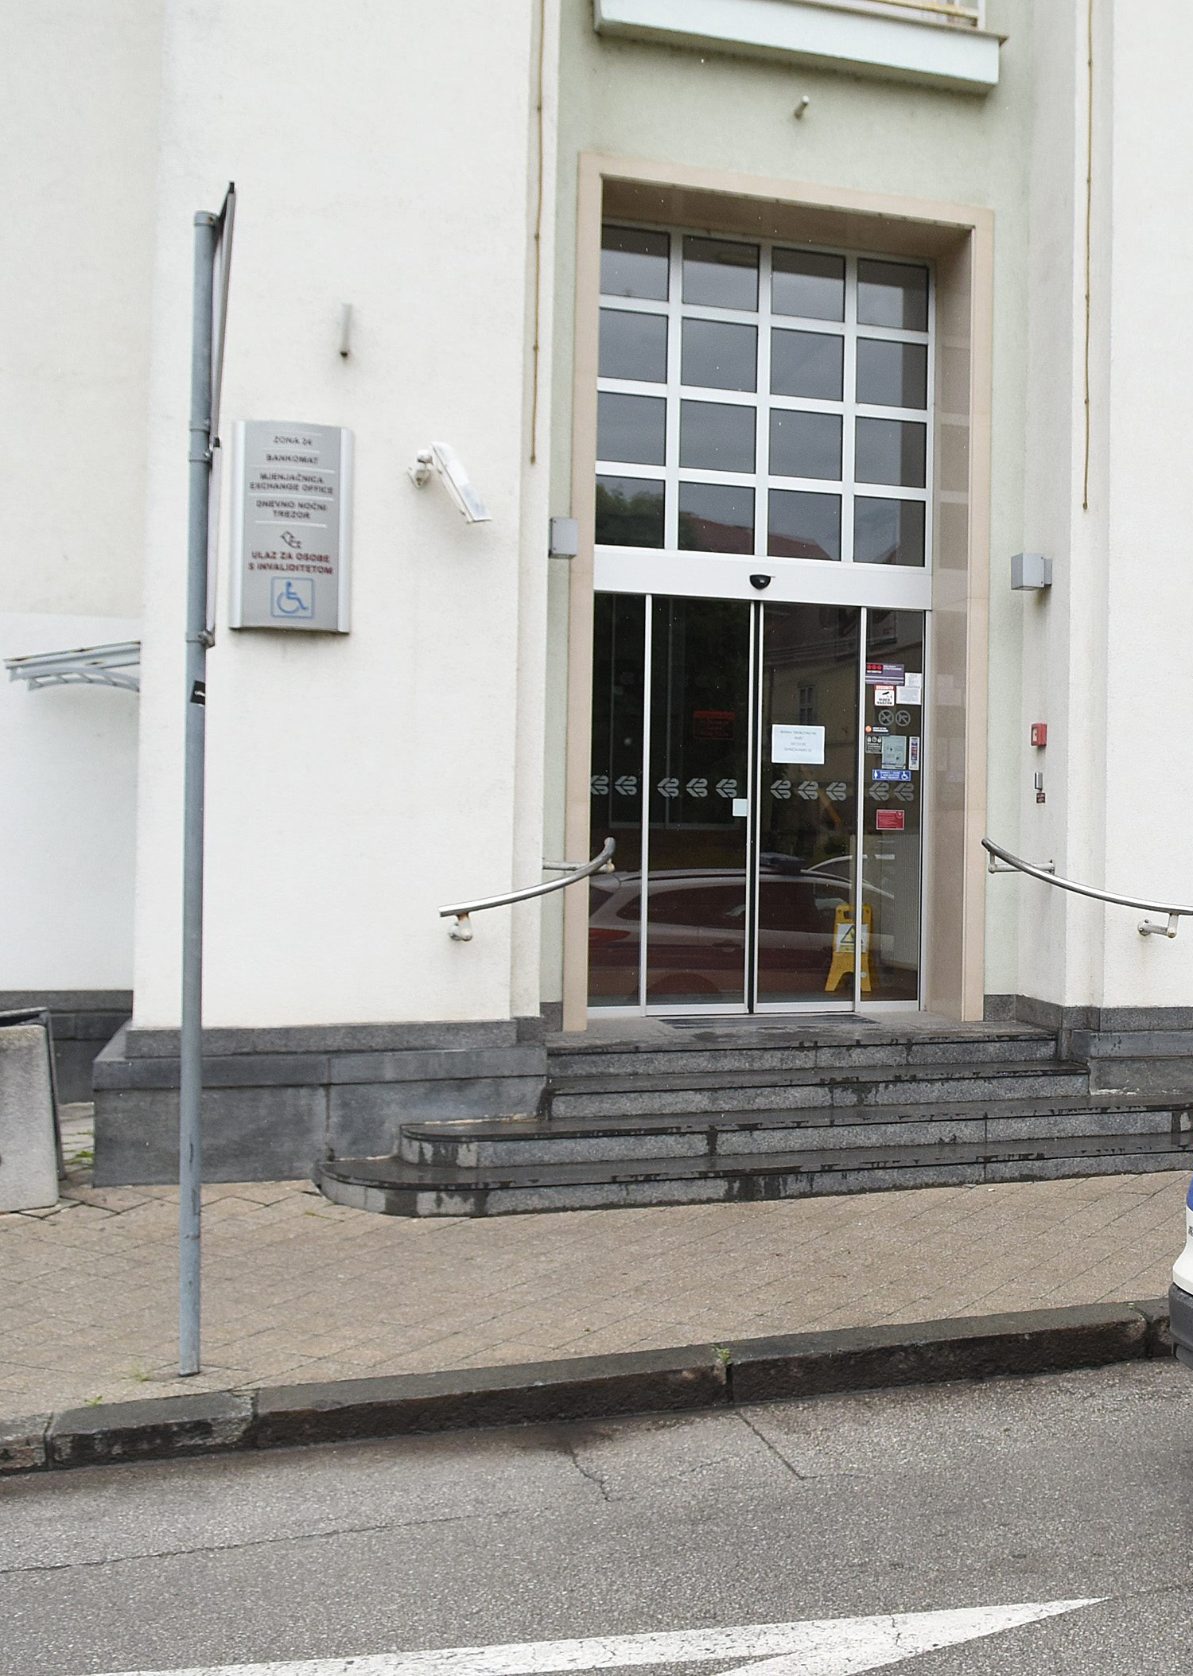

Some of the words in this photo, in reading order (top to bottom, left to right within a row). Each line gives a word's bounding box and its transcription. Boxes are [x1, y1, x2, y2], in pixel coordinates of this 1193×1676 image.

[267, 455, 318, 464] BANKOMAT
[250, 482, 299, 491] EXCHANGE
[302, 484, 334, 494] OFFICE
[256, 500, 295, 508] DNEVNO
[273, 509, 310, 519] TREZOR
[251, 551, 276, 560] ULAZ
[280, 552, 293, 561] ZA
[296, 552, 330, 563] OSOBE
[257, 563, 333, 574] INVALIDITETOM
